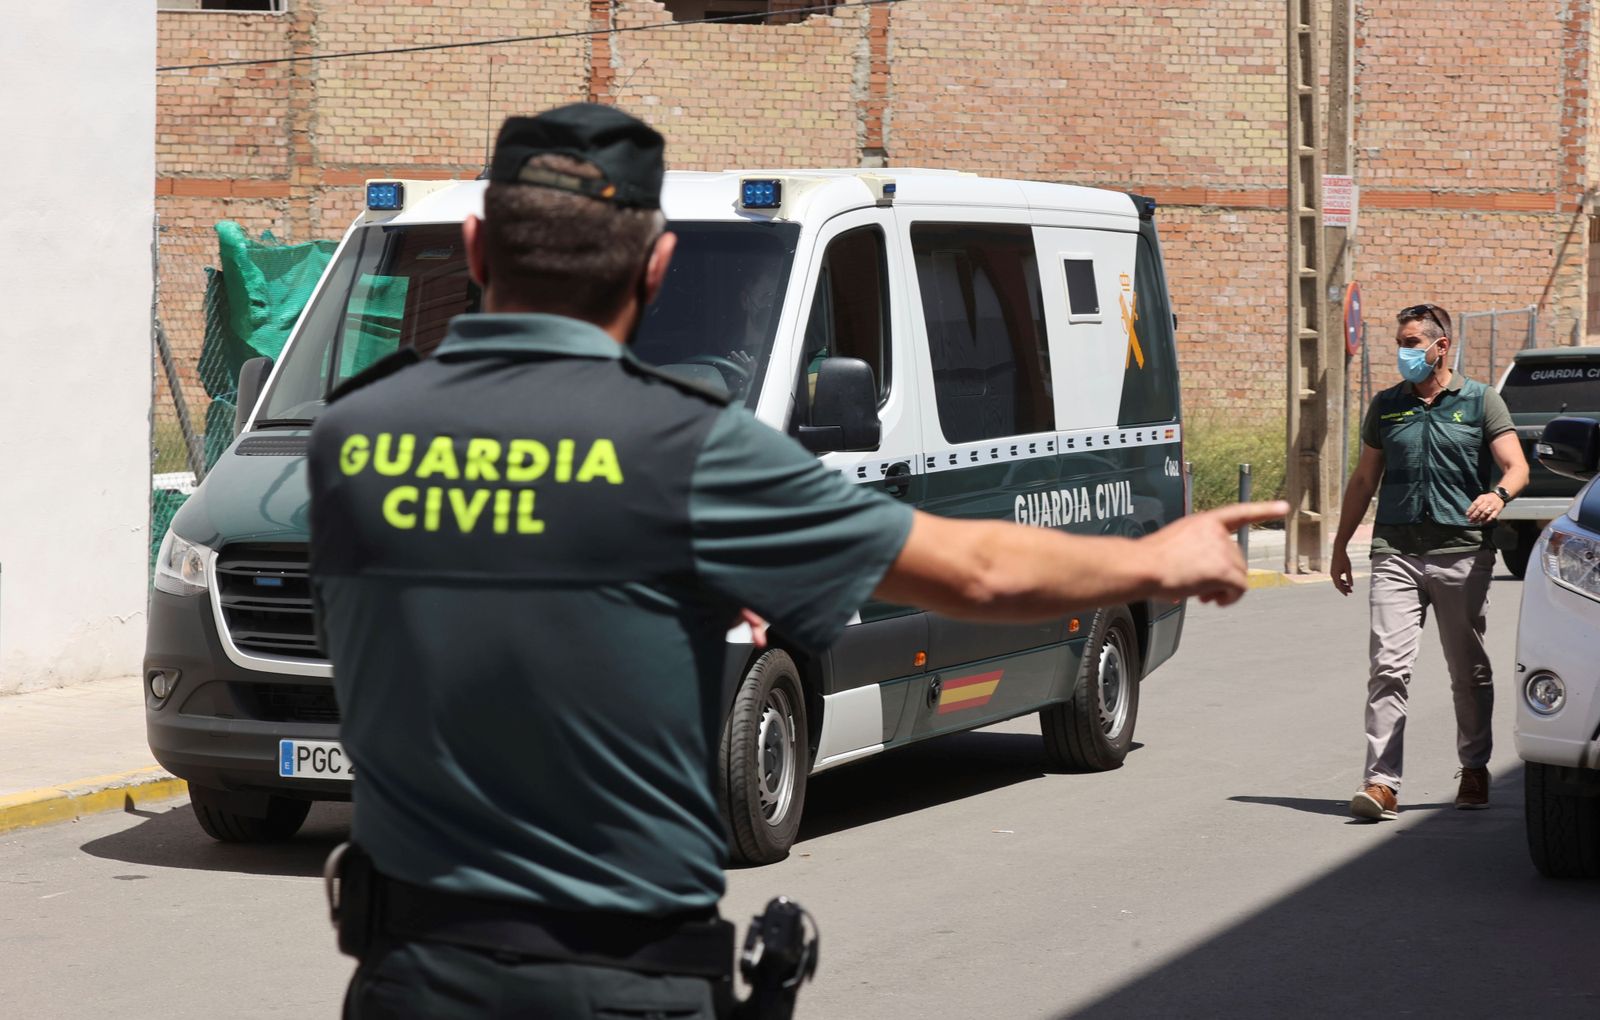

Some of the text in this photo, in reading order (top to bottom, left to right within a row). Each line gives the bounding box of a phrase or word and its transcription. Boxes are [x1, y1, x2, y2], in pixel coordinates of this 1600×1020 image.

[1530, 368, 1583, 380] GUARDIA
[340, 433, 624, 484] GUARDIA
[382, 485, 545, 534] CIVIL
[1014, 480, 1134, 528] GUARDIA CIVIL
[297, 746, 341, 773] PGC
